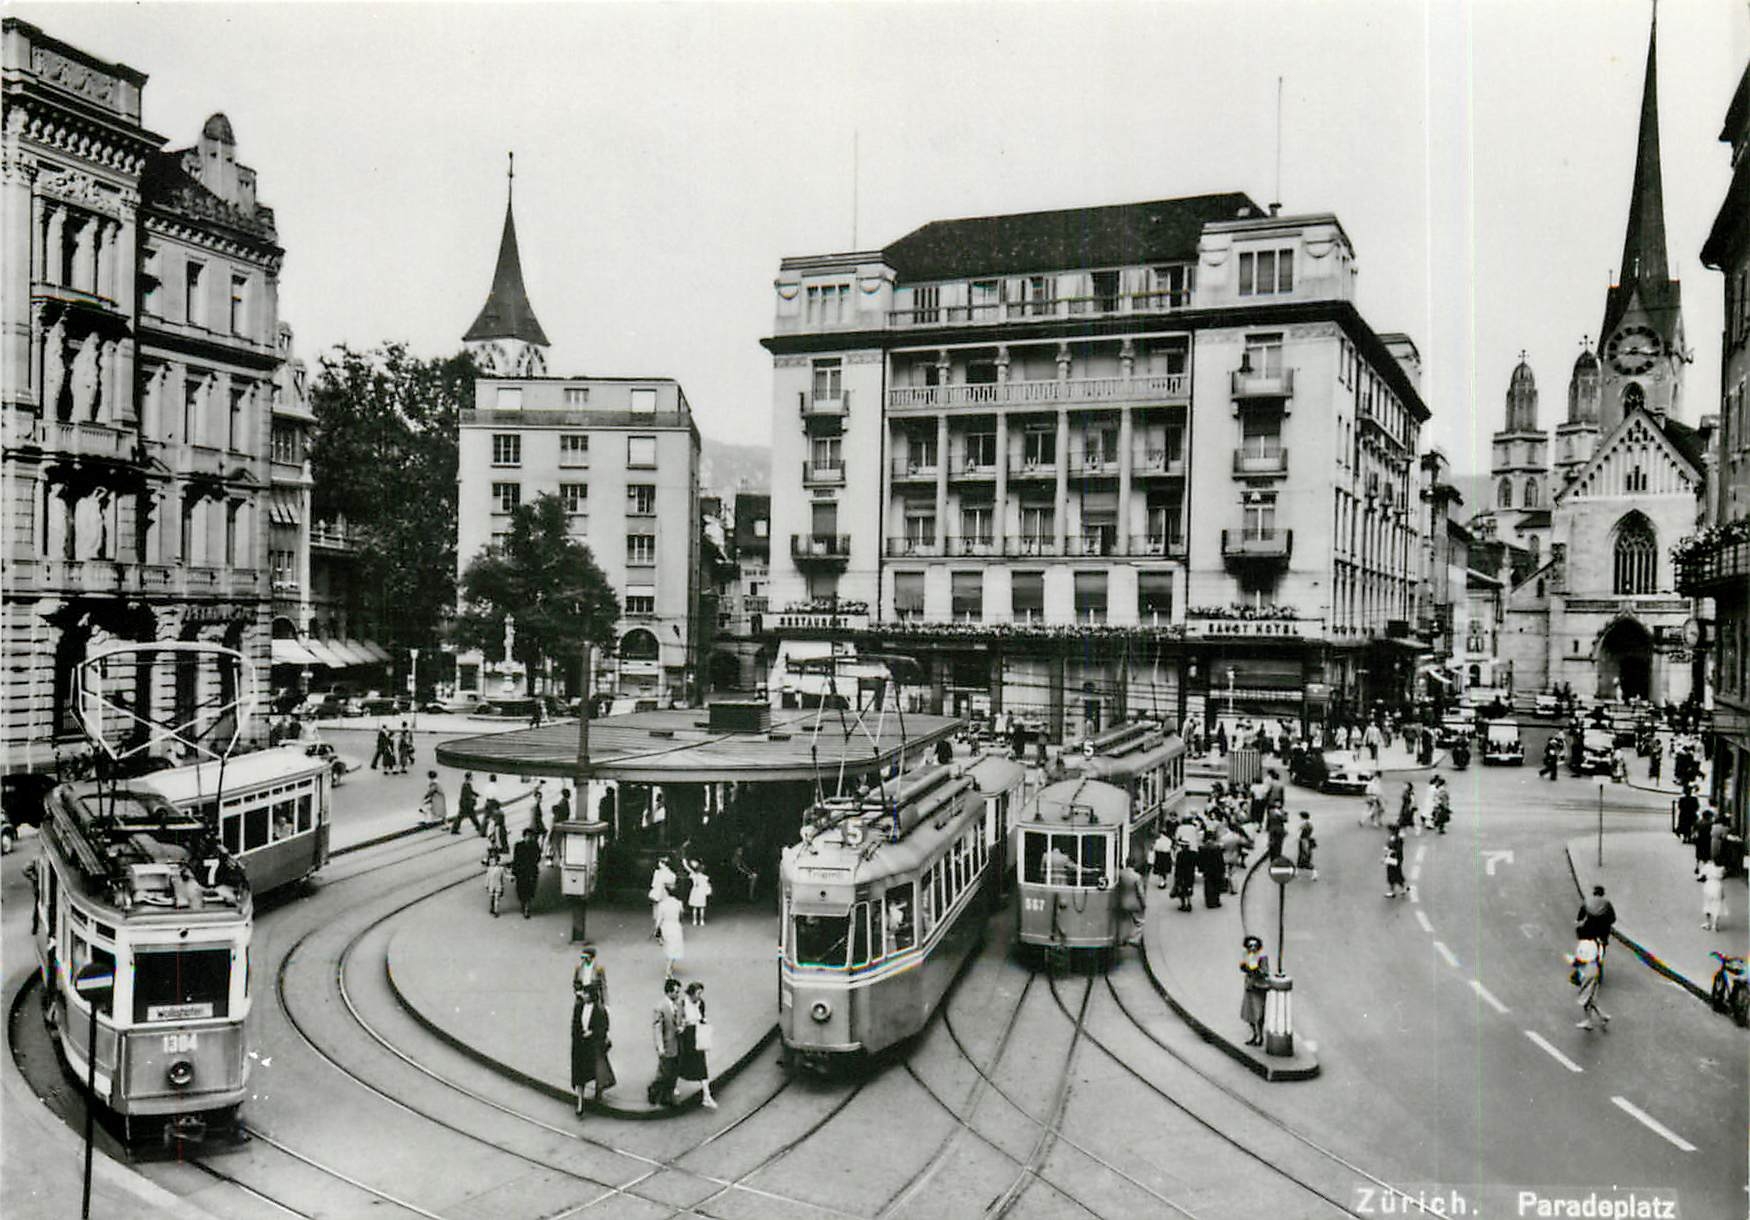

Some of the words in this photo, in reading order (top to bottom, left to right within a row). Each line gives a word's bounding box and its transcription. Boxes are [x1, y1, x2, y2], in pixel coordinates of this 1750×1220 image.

[1255, 624, 1298, 635] HOTEL
[1083, 740, 1094, 757] 5
[846, 818, 863, 845] 5
[203, 859, 219, 886] 7
